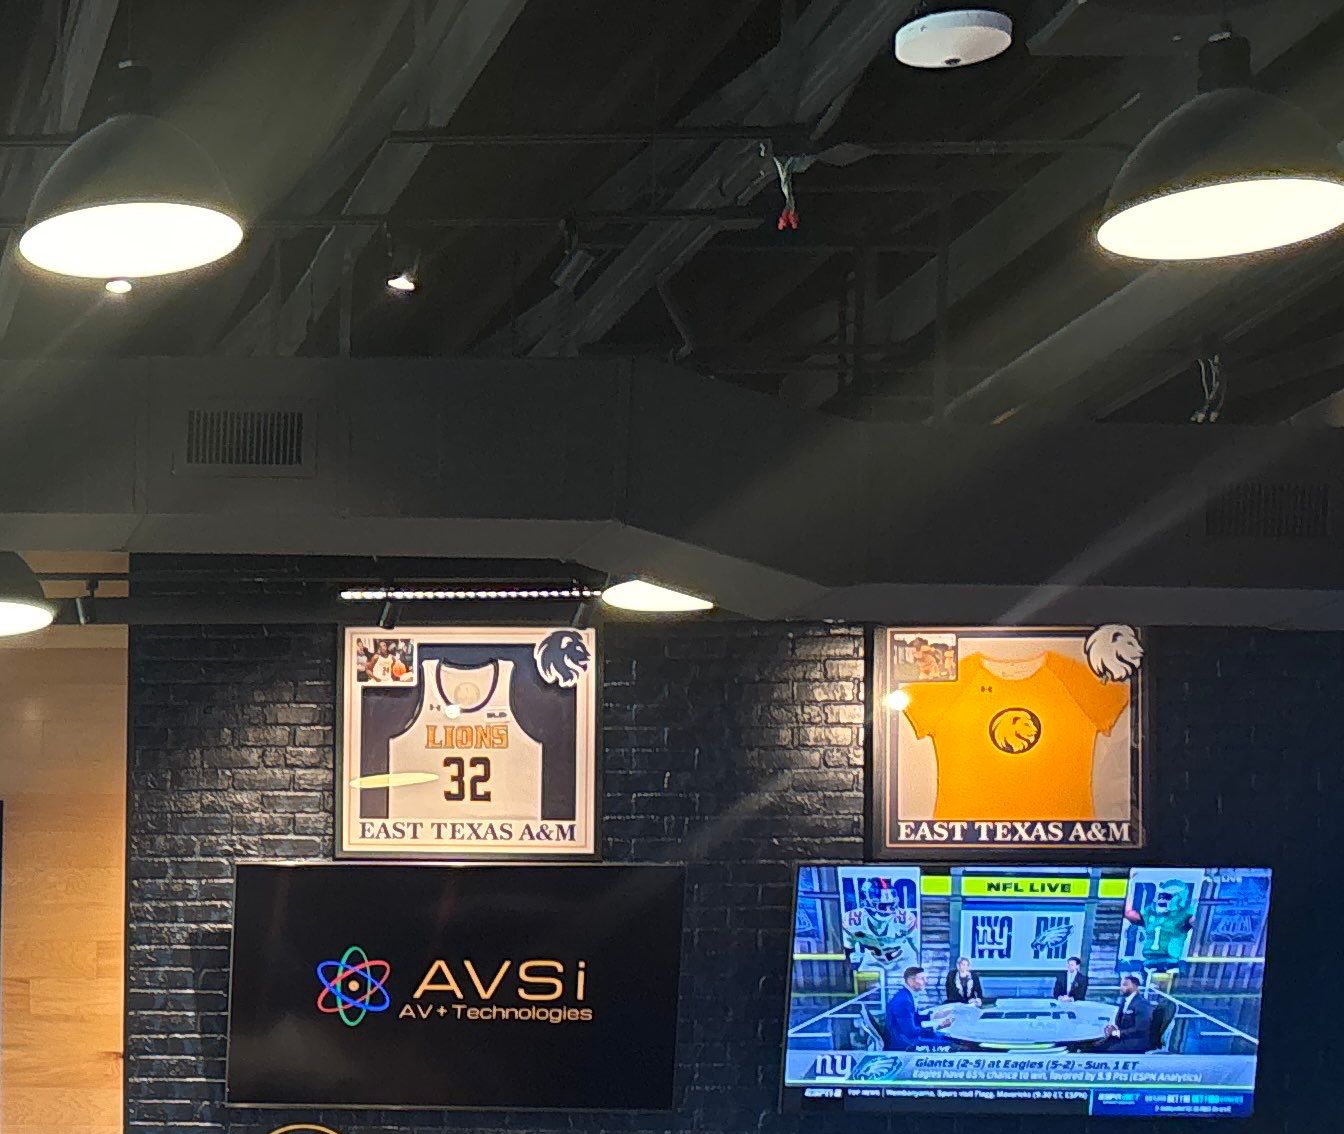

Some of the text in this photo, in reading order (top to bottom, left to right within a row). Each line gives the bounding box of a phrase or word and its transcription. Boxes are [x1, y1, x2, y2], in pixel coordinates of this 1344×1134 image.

[425, 724, 509, 750] LIONS
[443, 756, 492, 802] 32
[358, 821, 577, 842] EAST TEXAS A&M
[897, 821, 1131, 842] EAST TEXAS A&M
[986, 882, 1072, 893] NFL LIVE
[412, 959, 586, 1001] AVSi
[451, 1004, 593, 1024] Technologies
[915, 1058, 955, 1068] Giants
[956, 1059, 986, 1069] (2-5)
[987, 1060, 1002, 1068] at
[1003, 1060, 1044, 1071] Eagles
[1045, 1060, 1076, 1071] (5-2)
[1121, 1061, 1140, 1070] ET
